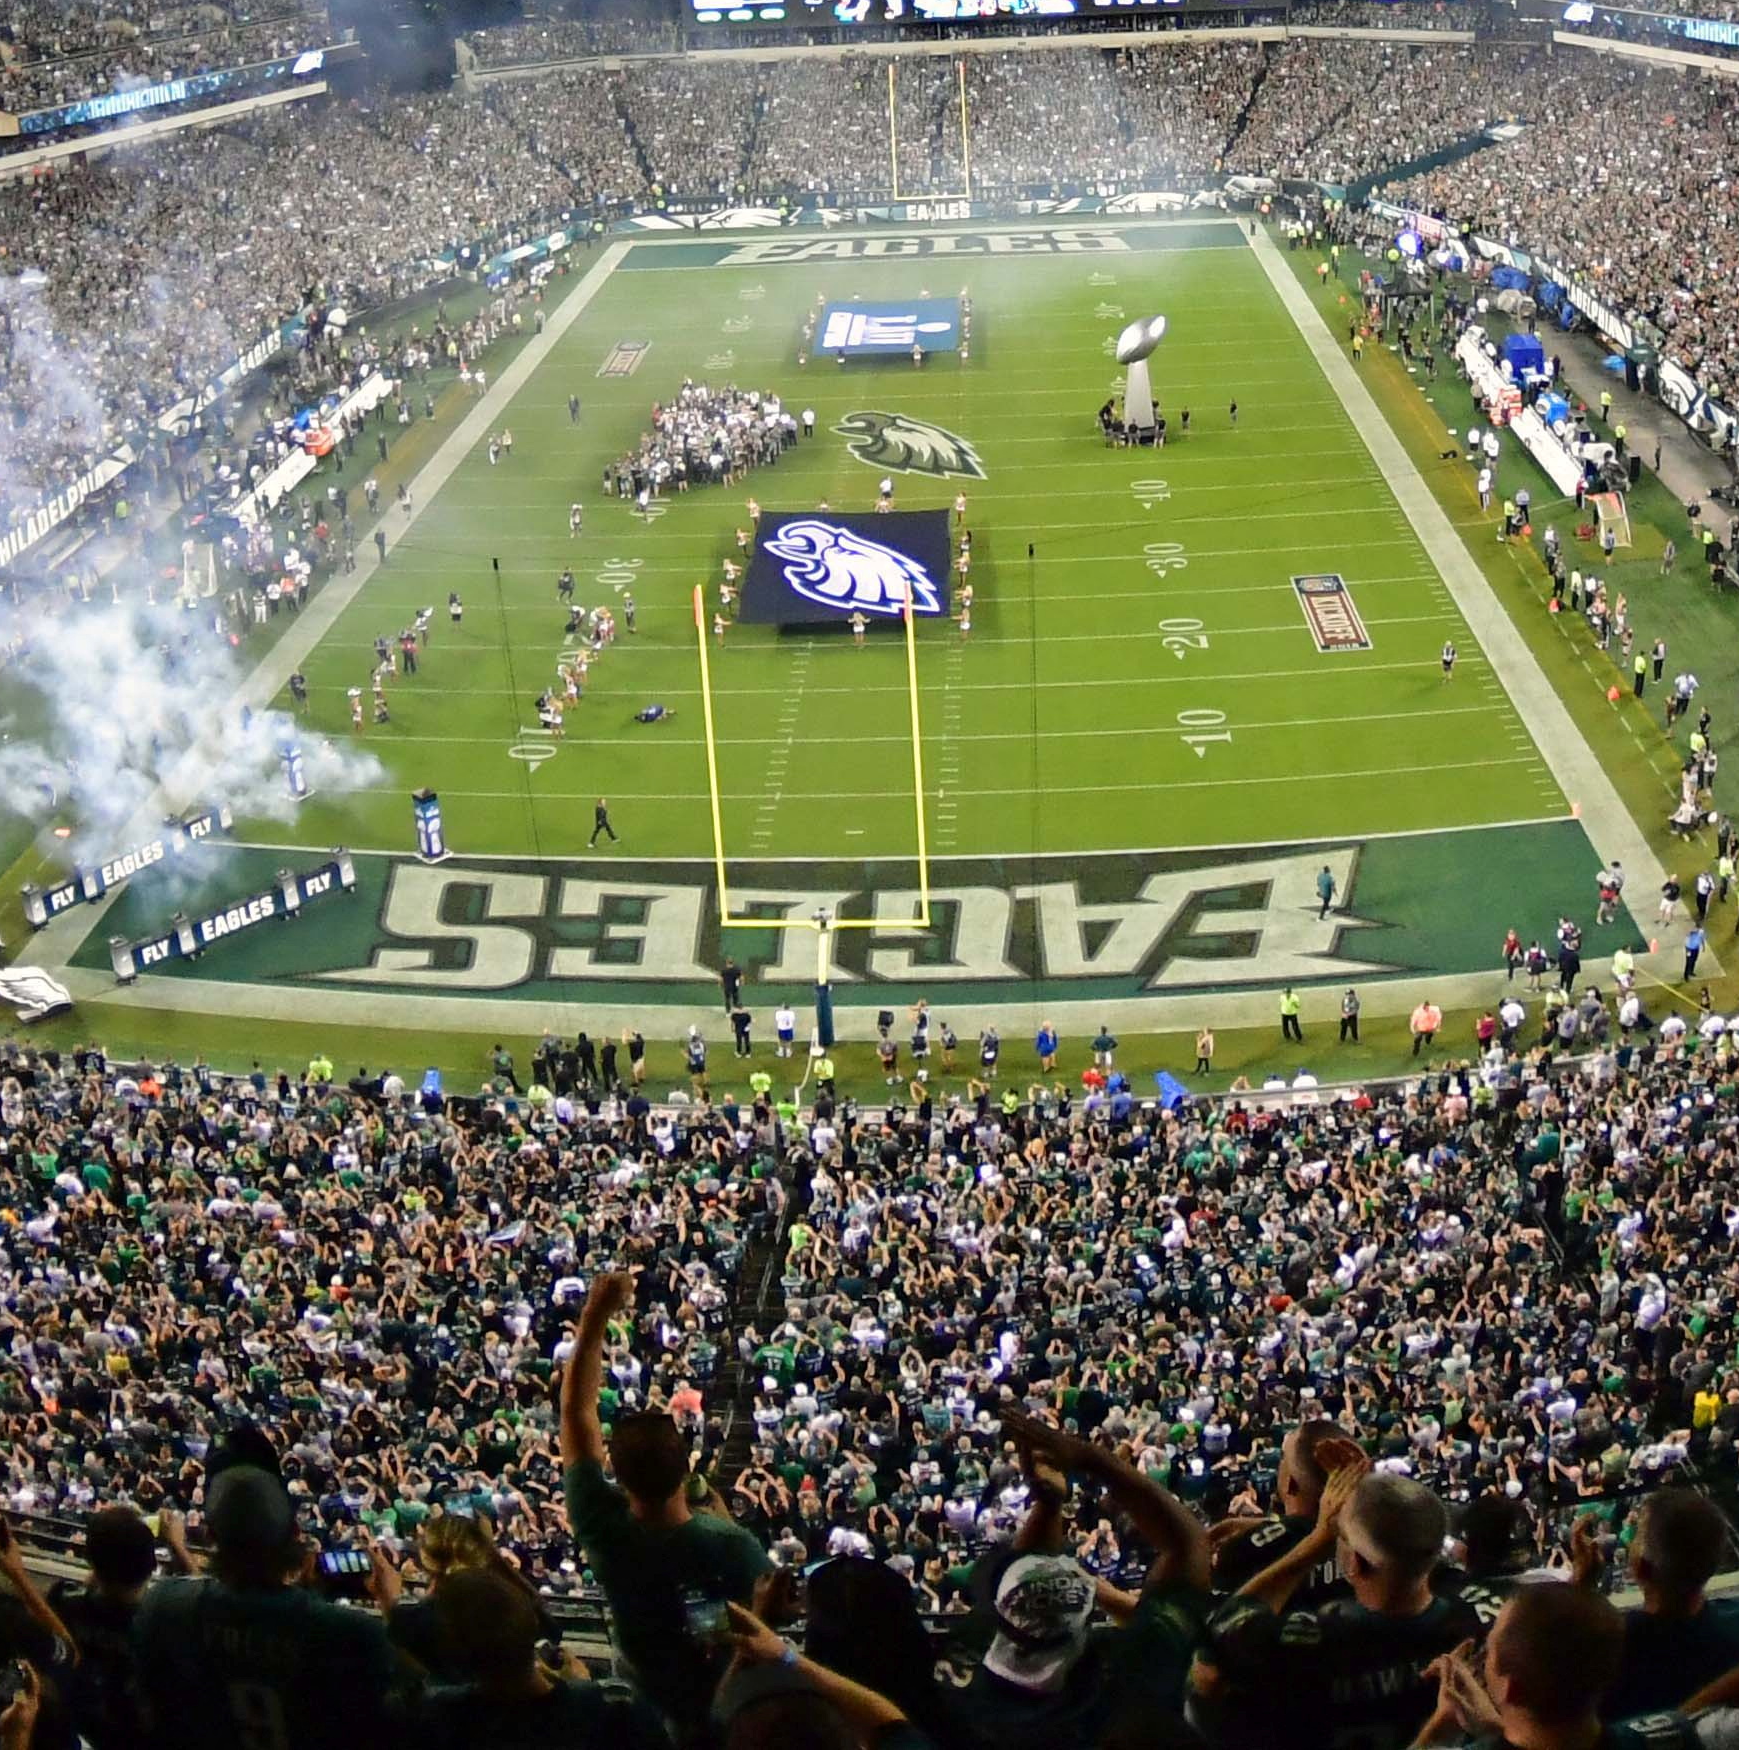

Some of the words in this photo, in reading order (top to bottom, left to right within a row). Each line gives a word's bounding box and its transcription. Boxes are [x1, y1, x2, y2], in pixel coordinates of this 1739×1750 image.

[716, 229, 1132, 266] EAGLES
[239, 330, 282, 374] EAGLES
[596, 558, 644, 584] 30
[1143, 542, 1188, 569] 30
[1158, 618, 1210, 649] 20
[508, 725, 566, 760] 10
[1176, 708, 1233, 744] 10
[51, 885, 75, 911] FLY
[100, 841, 164, 888] EAGLES
[189, 815, 212, 840] FLY
[141, 939, 170, 965] FLY
[199, 894, 275, 942] EAGLES
[304, 871, 333, 898] FLY
[312, 844, 1427, 990] EAGLES
